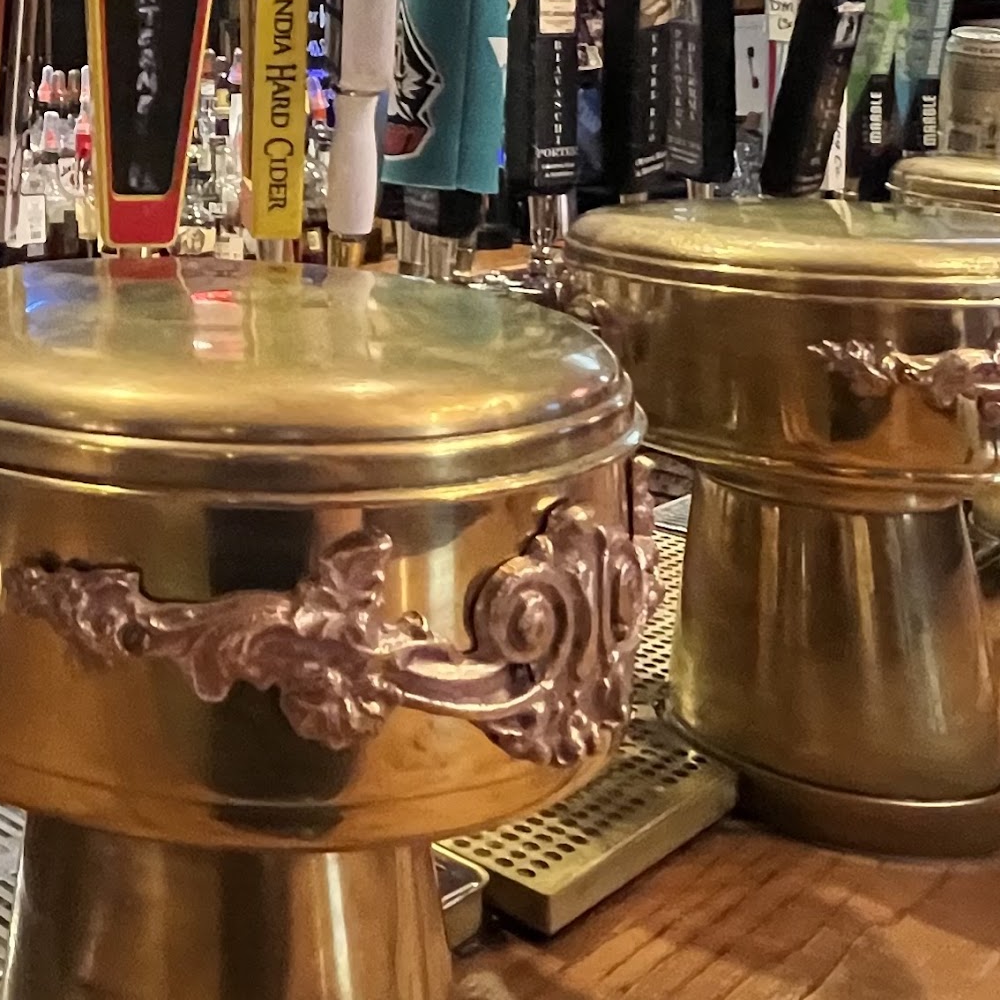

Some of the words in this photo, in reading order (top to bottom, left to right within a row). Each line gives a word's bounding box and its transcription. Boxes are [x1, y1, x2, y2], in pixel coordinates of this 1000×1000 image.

[266, 63, 297, 129] HARD
[869, 91, 883, 144] MARBLE
[922, 95, 937, 147] MARBLE
[263, 138, 295, 213] CIDER
